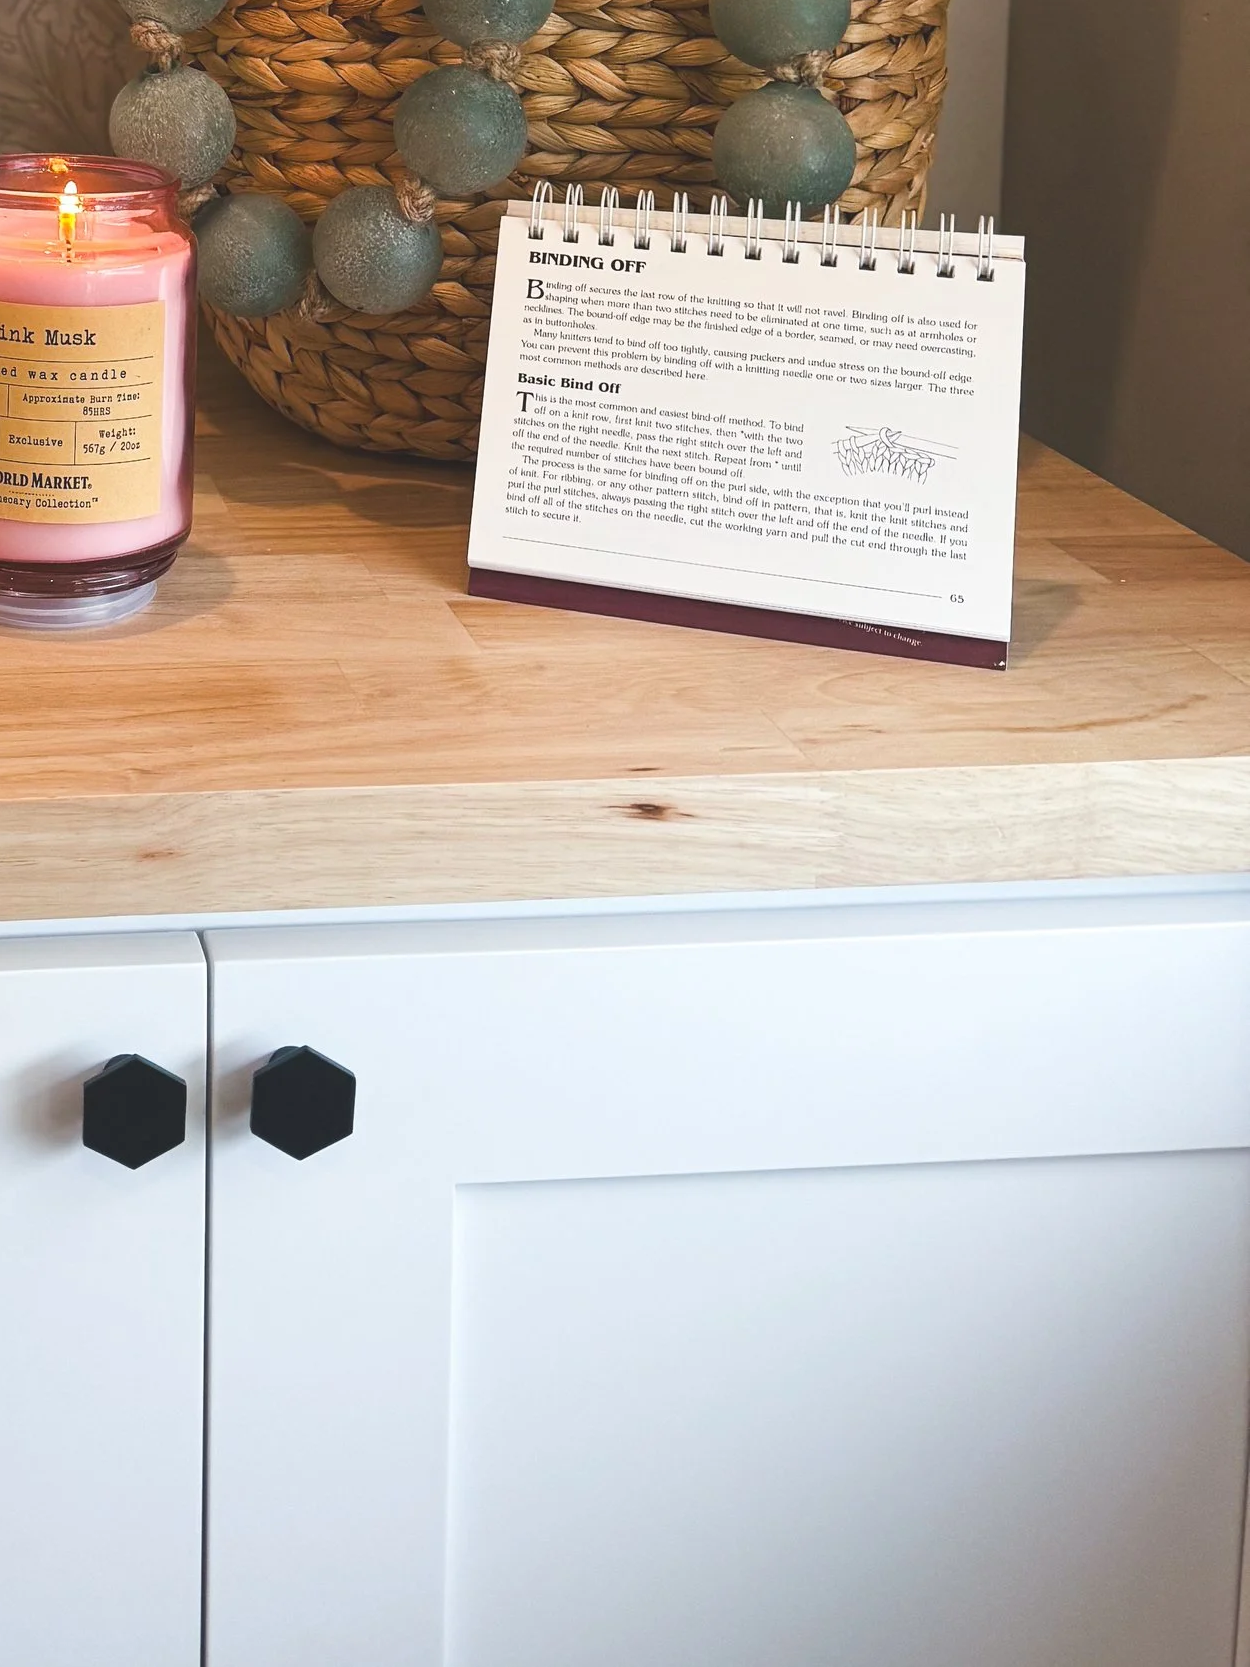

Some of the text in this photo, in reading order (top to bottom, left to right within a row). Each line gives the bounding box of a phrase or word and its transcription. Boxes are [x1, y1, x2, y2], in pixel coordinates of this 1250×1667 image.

[528, 250, 647, 274] BINDING OFF
[574, 283, 587, 293] off
[588, 287, 622, 297] secures
[623, 287, 639, 298] the
[640, 290, 656, 300] last
[658, 293, 676, 302] row
[677, 293, 688, 303] of
[689, 294, 705, 304] the
[706, 296, 741, 310] knitting
[44, 329, 97, 346] Musk
[28, 369, 59, 381] wax
[69, 368, 127, 381] candle
[517, 372, 622, 395] Basic Bind Off
[22, 392, 140, 405] Approximate Burn Time:
[82, 406, 111, 416] 85HRS
[98, 427, 136, 440] Weight:
[8, 434, 63, 448] Exclusive
[83, 441, 141, 455] 567g / 20oz
[949, 593, 965, 604] 65
[854, 620, 883, 635] subject
[884, 628, 893, 637] to
